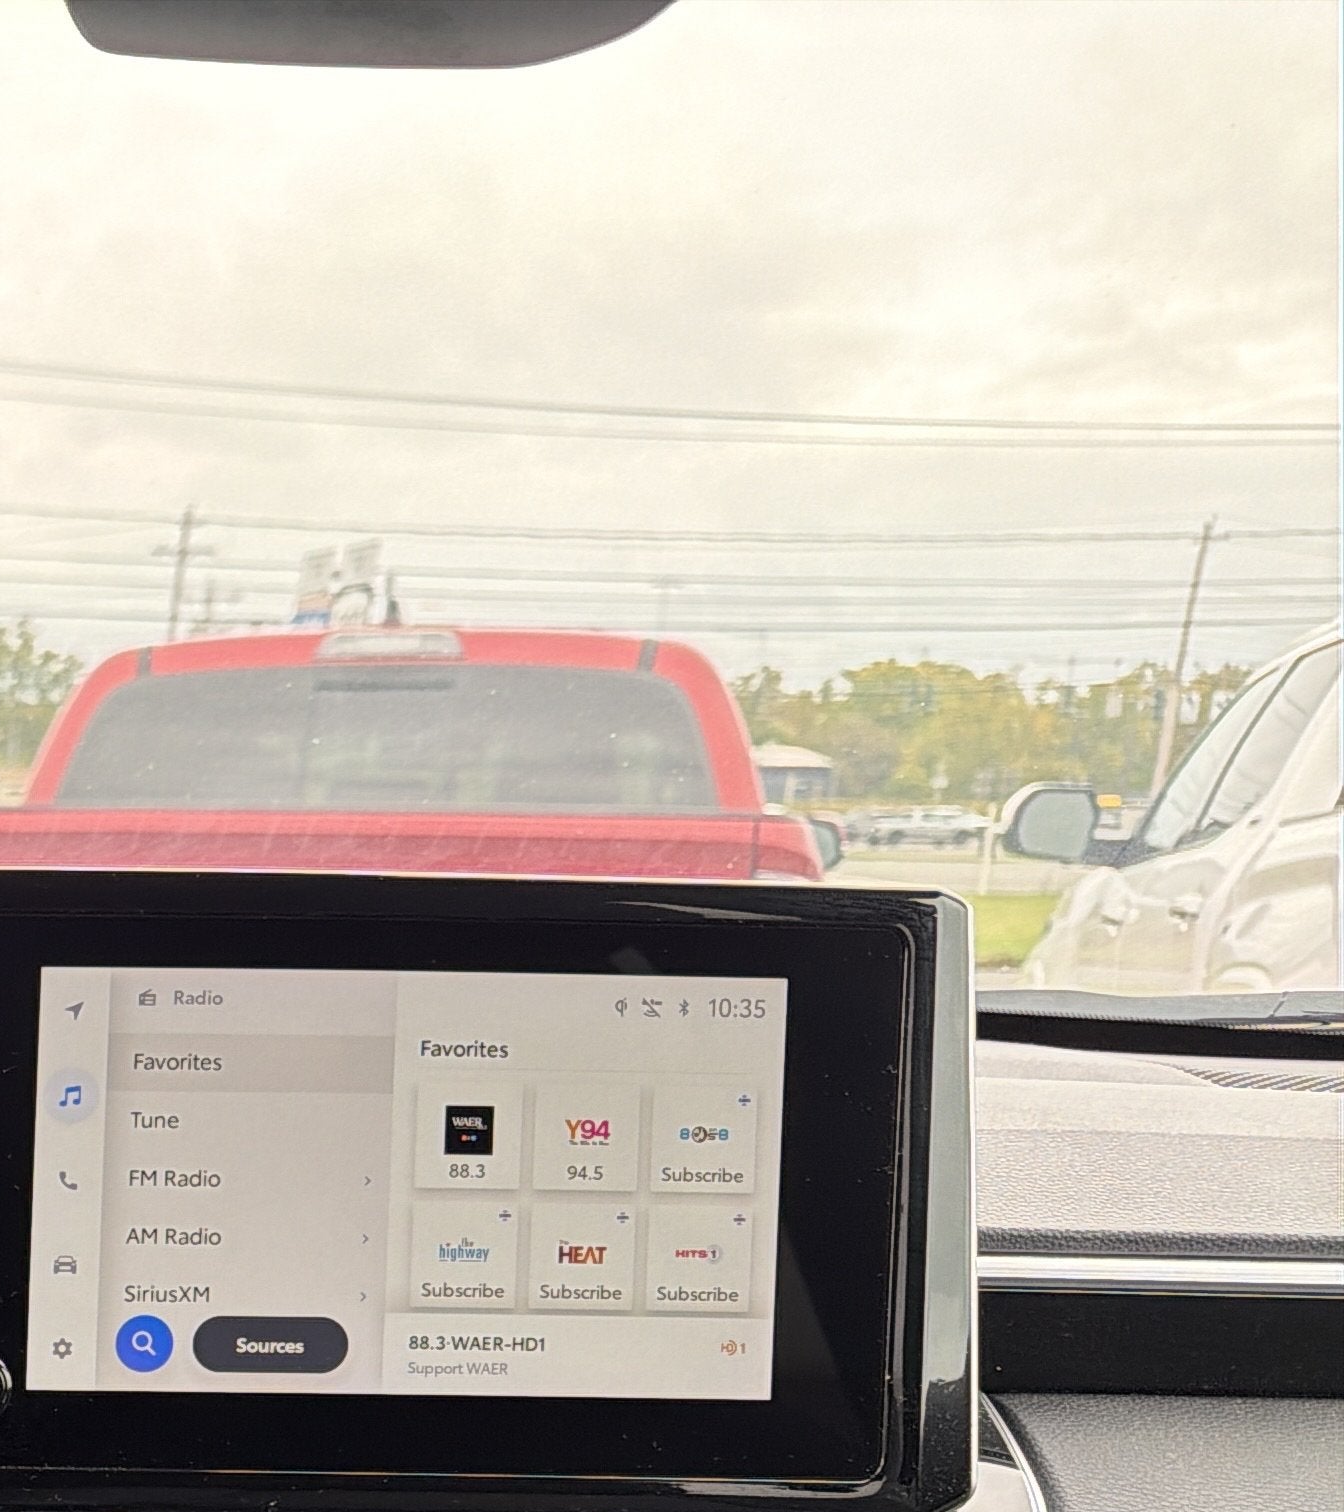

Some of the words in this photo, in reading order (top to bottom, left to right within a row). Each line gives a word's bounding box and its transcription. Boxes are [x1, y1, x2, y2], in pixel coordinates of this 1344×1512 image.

[173, 989, 224, 1006] Radio
[708, 998, 766, 1019] 10:35
[420, 1040, 509, 1059] Favorites
[132, 1053, 223, 1072] Favorites
[130, 1111, 180, 1130] Tune
[565, 1119, 611, 1140] Y94
[128, 1170, 158, 1188] FM
[164, 1169, 221, 1188] Radio
[448, 1164, 486, 1179] 88.3
[567, 1166, 604, 1181] 94.5
[661, 1168, 744, 1183] Subscribe
[125, 1228, 158, 1246] AM
[165, 1227, 222, 1246] Radio
[439, 1244, 490, 1262] highway
[558, 1246, 607, 1265] HEAT
[124, 1285, 211, 1304] SiriusXM
[421, 1283, 505, 1299] Subscribe
[539, 1285, 623, 1301] Subscribe
[656, 1286, 740, 1303] Subscribe
[235, 1337, 305, 1355] Sources
[407, 1362, 463, 1378] Support
[466, 1363, 508, 1376] WAER
